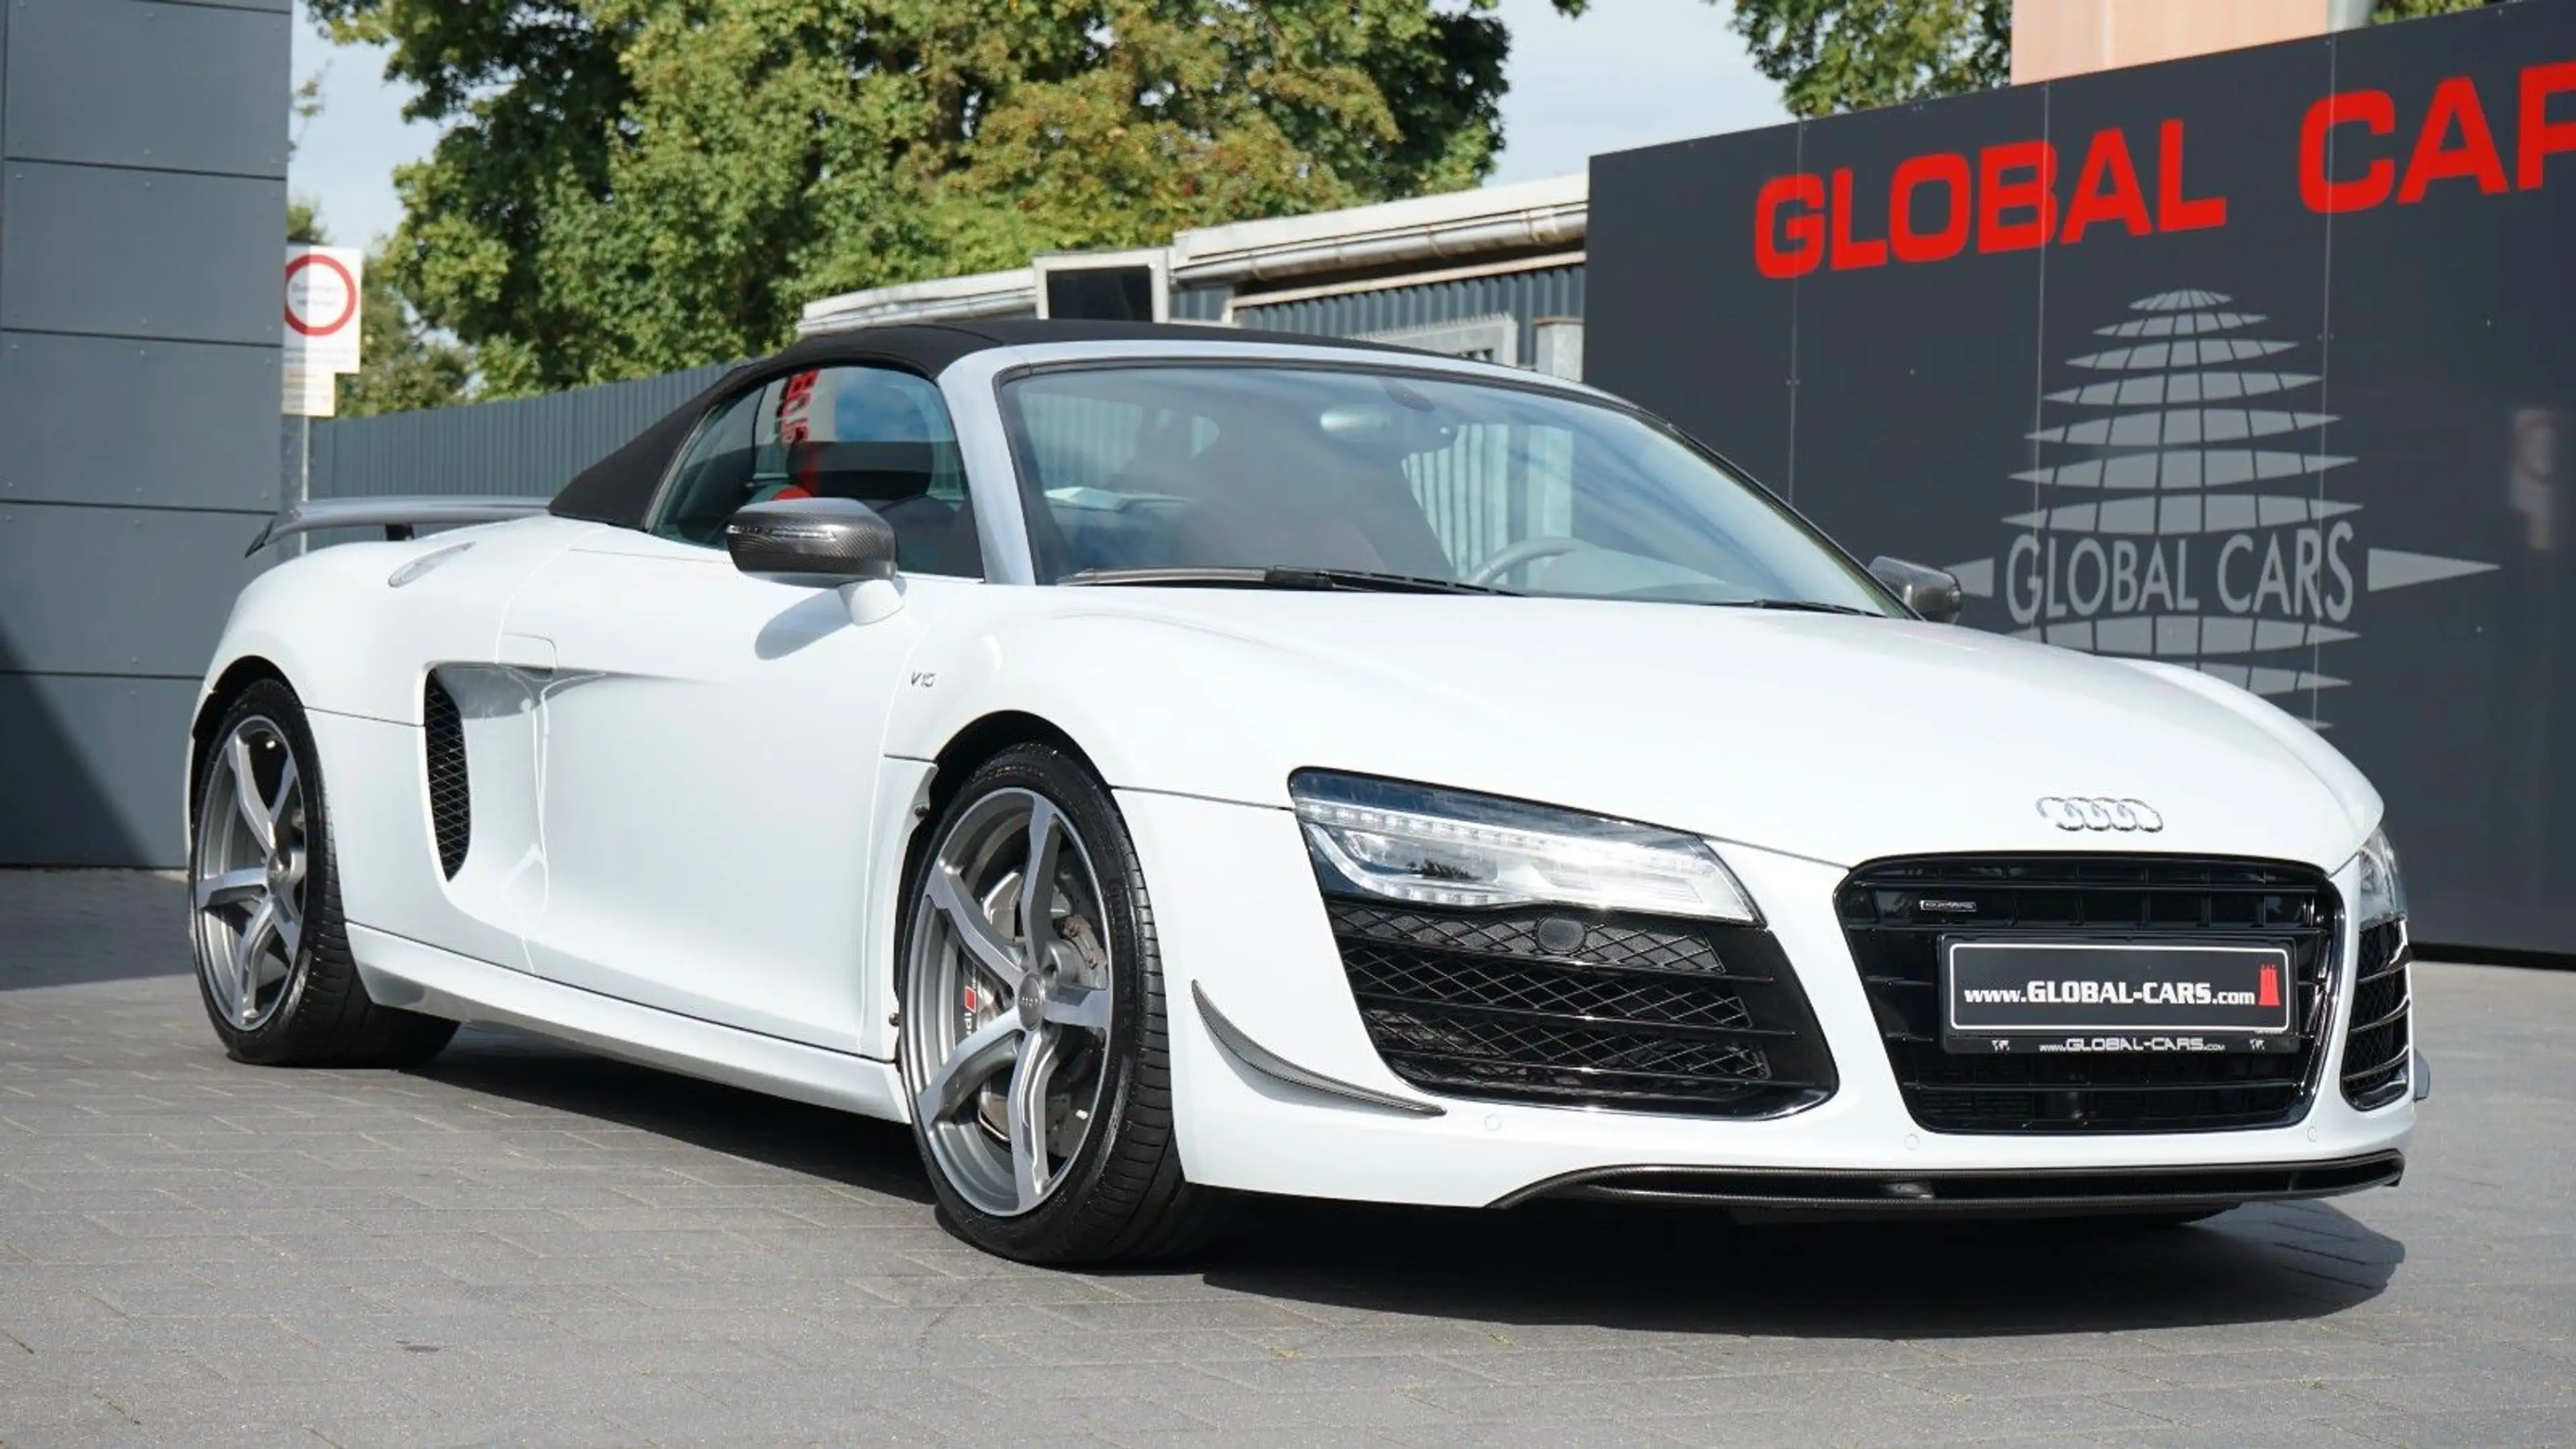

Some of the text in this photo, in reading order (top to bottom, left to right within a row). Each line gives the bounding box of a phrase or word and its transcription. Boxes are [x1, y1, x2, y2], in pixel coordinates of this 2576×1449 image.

[1755, 119, 2227, 278] GLOBAL
[2006, 520, 2353, 624] GLOBAL CARS
[1964, 981, 2255, 1005] www.GLOBAL-CARS.com
